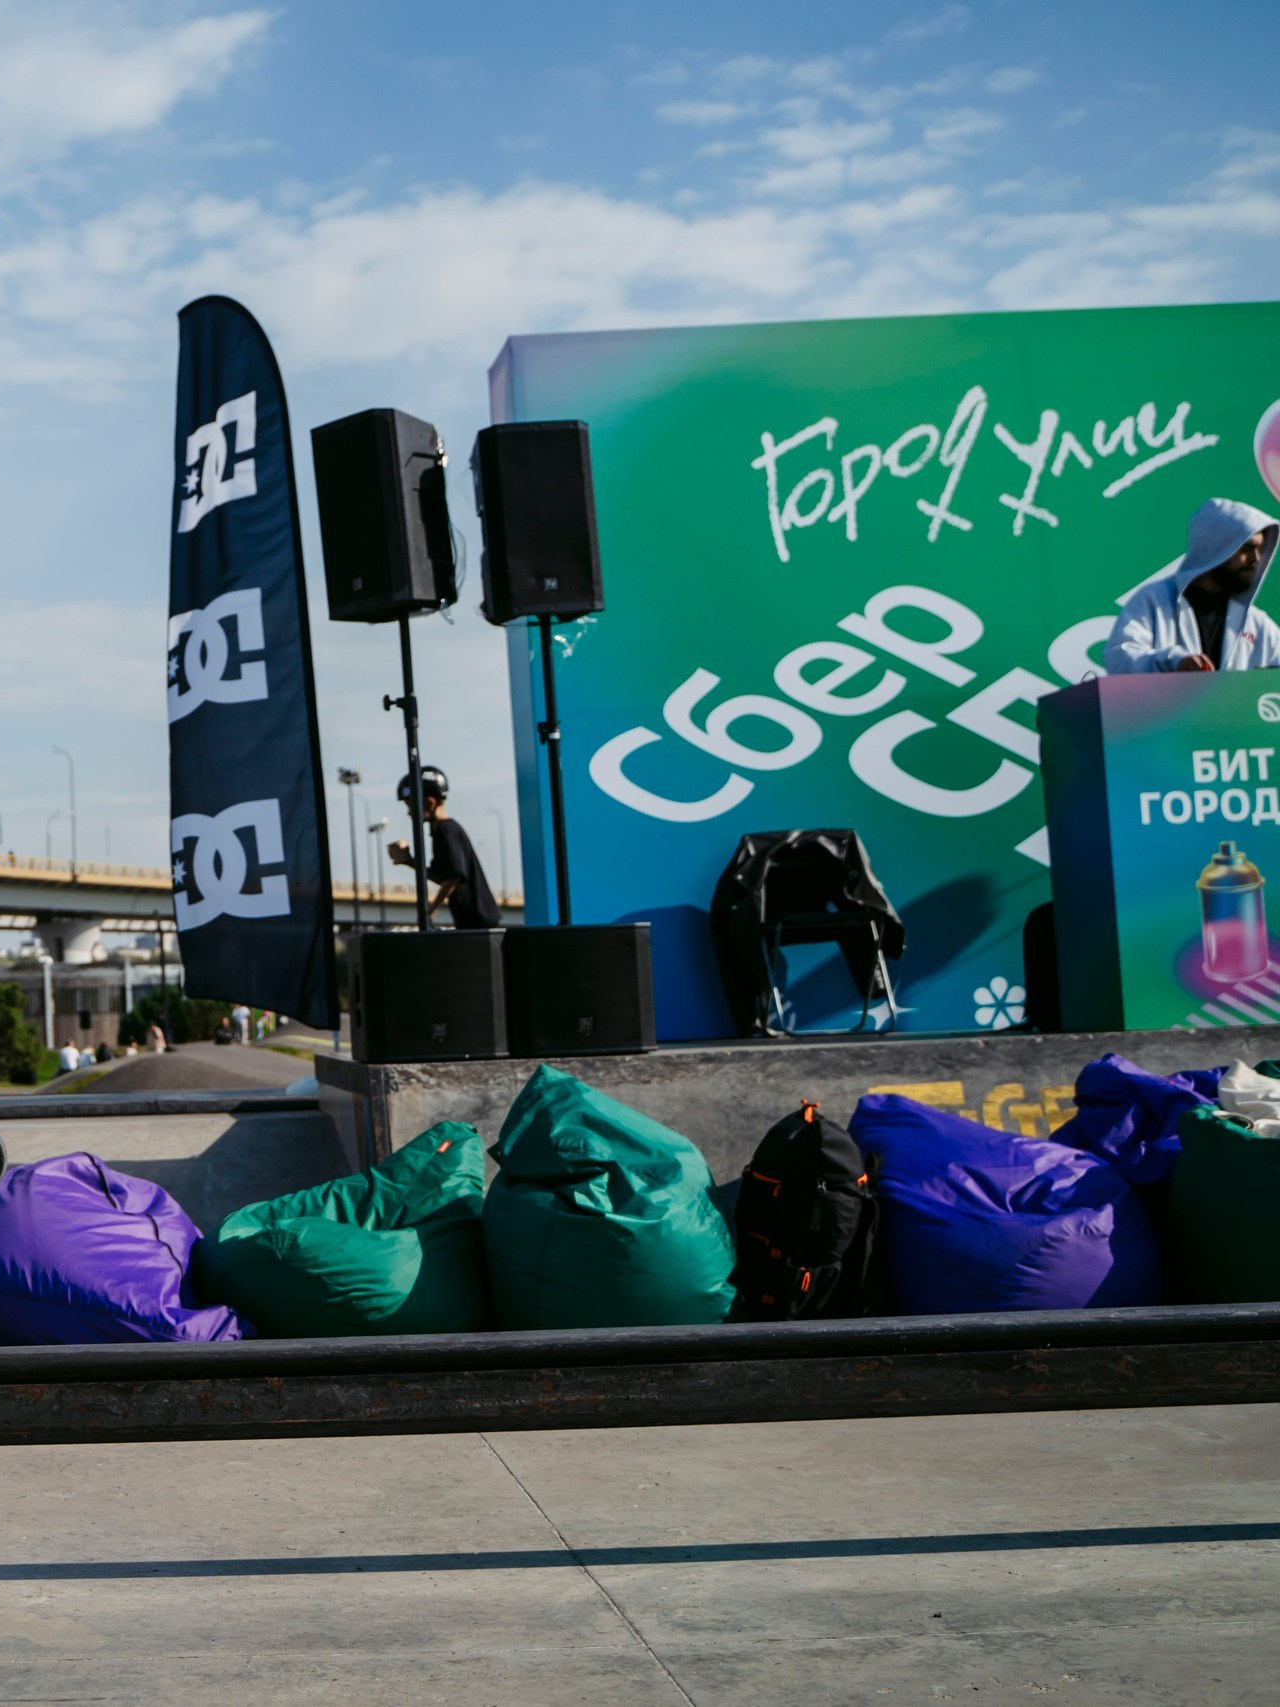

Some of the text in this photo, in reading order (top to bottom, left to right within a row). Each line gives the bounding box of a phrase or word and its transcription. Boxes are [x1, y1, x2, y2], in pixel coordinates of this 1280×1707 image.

[751, 385, 988, 563] Город
[588, 584, 985, 823] Сбер
[1192, 747, 1275, 784] БИТ
